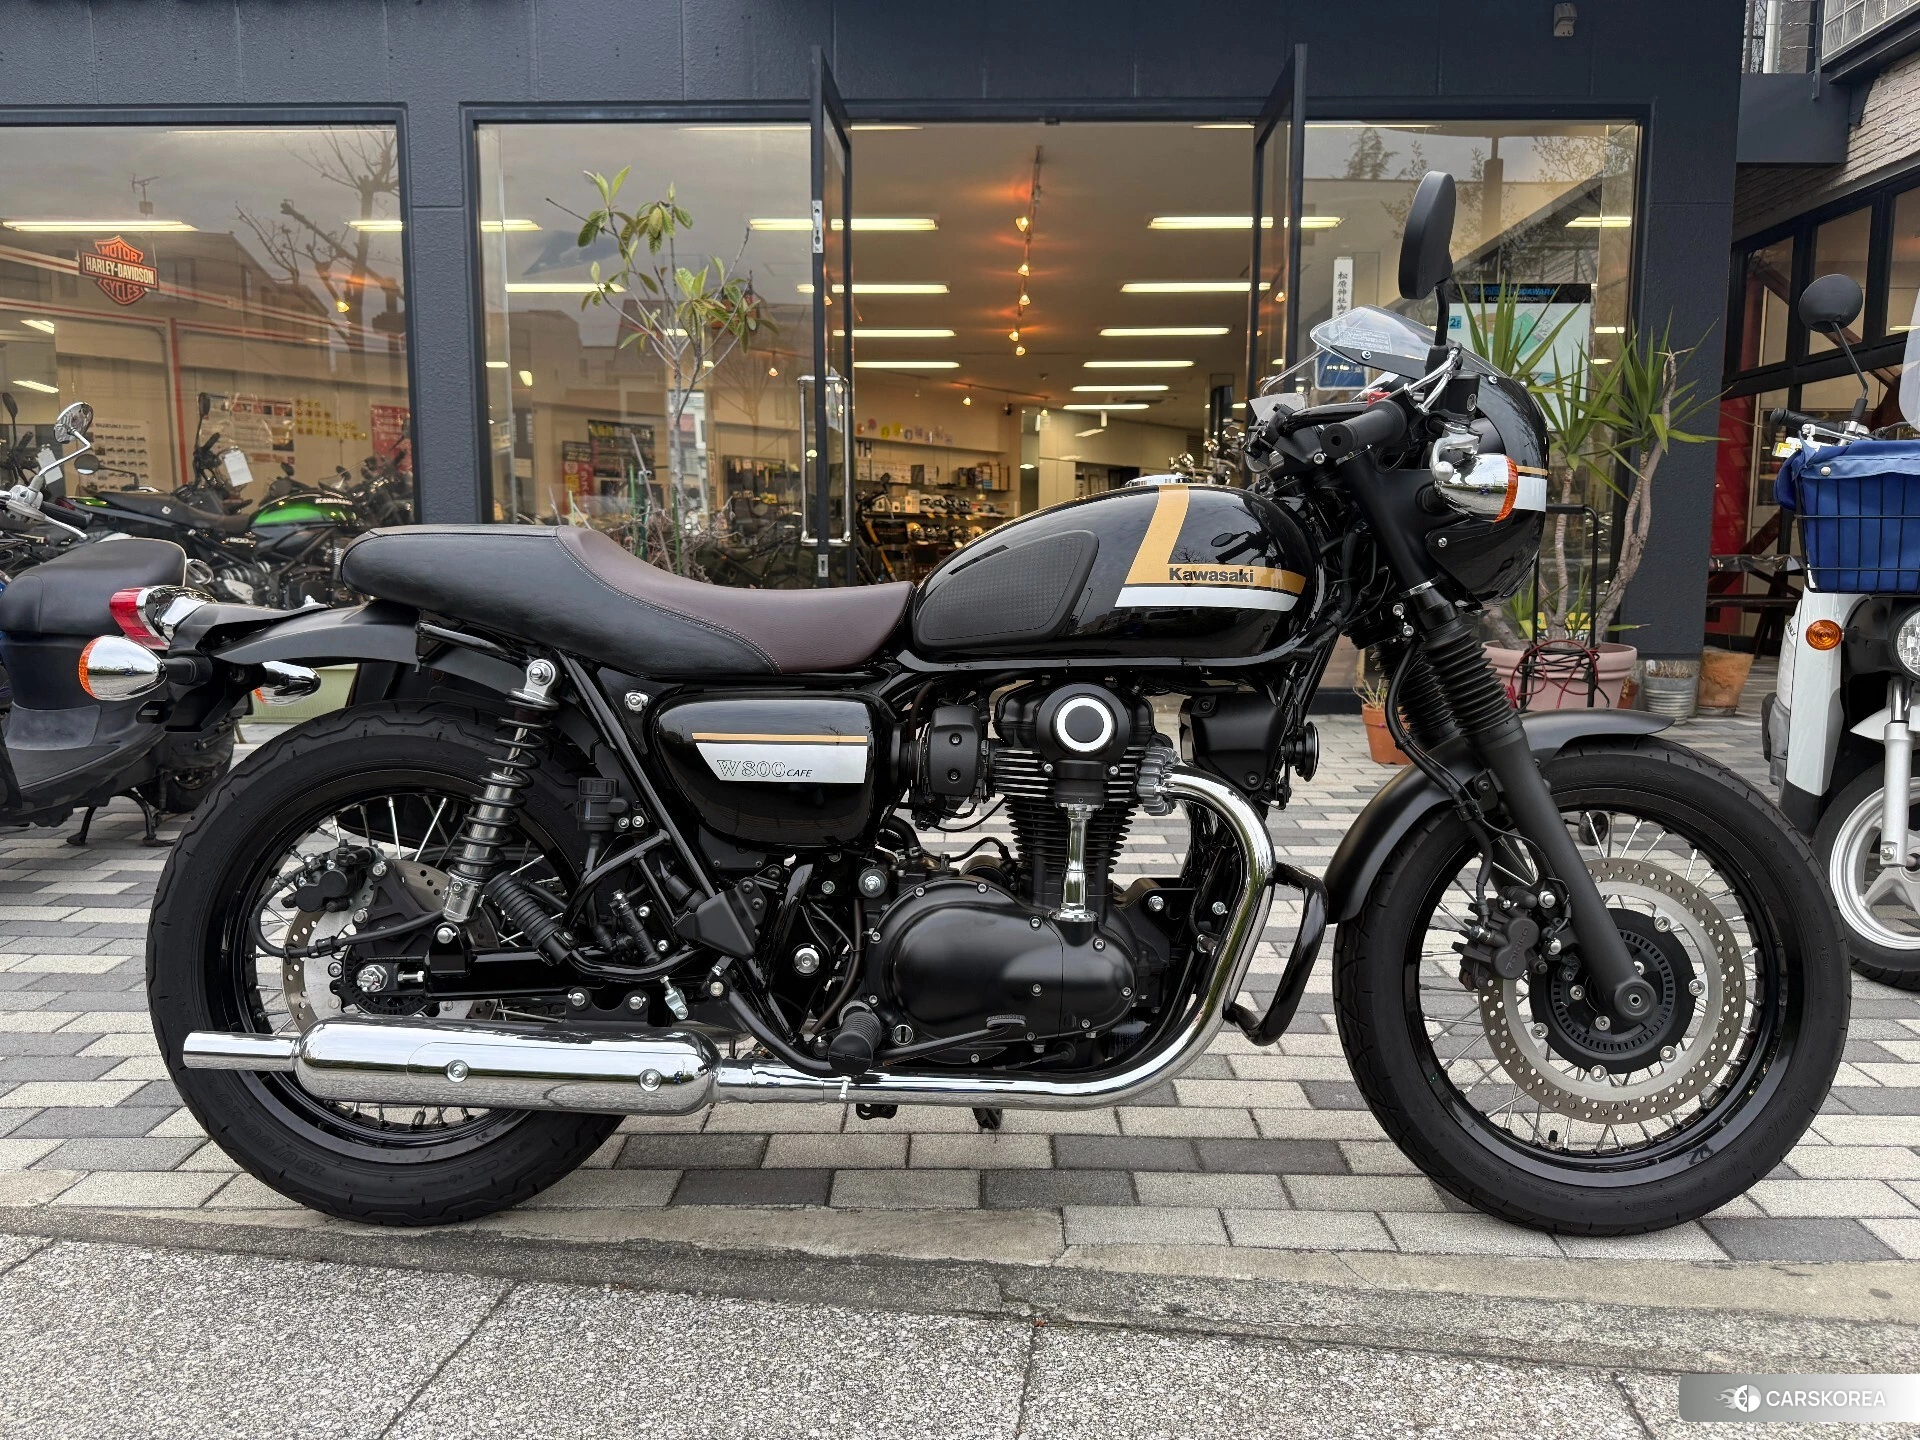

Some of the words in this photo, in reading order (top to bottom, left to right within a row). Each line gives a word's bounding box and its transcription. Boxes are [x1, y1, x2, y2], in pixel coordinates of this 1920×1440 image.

[101, 243, 138, 262] MOTOR
[85, 255, 155, 285] HARLEY-DAVIDSON
[103, 279, 140, 300] CYCLES
[1168, 567, 1254, 583] Kawasaki
[716, 759, 786, 778] W800
[786, 769, 813, 778] CAFE
